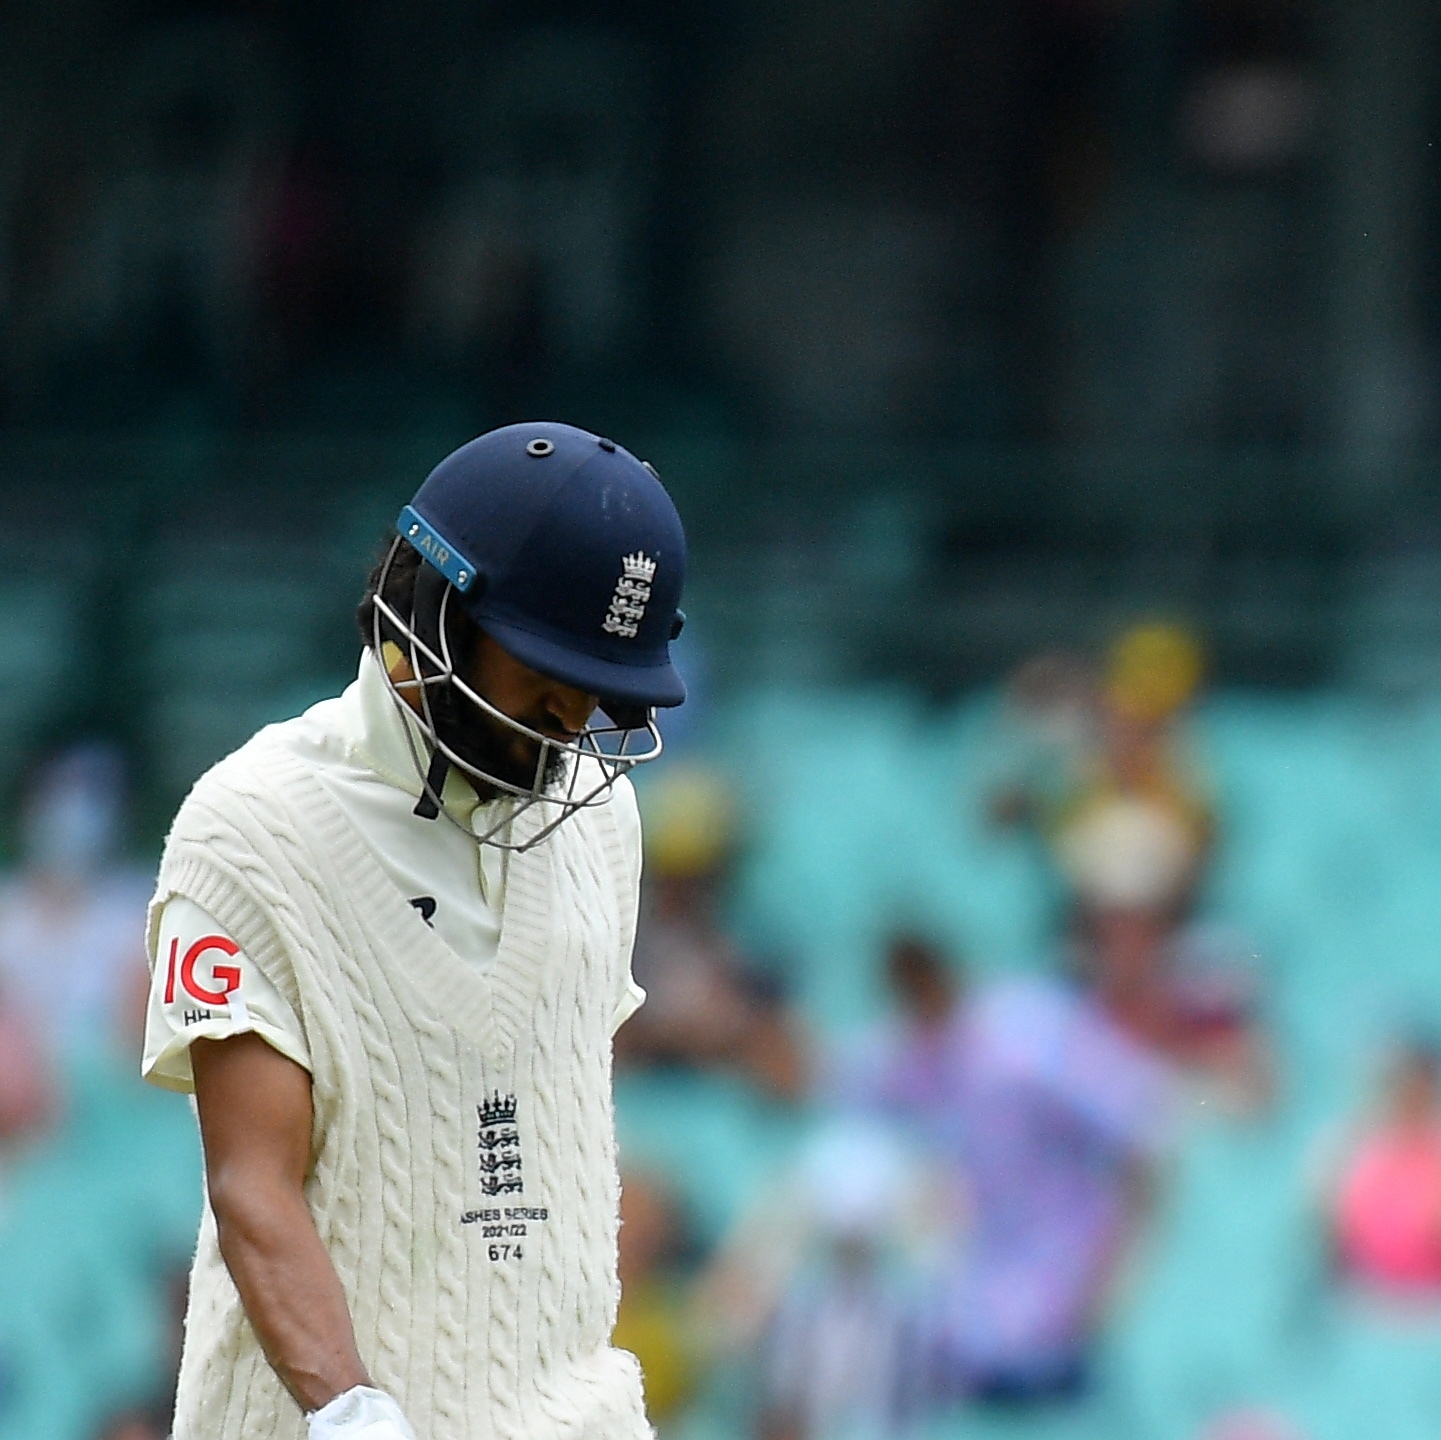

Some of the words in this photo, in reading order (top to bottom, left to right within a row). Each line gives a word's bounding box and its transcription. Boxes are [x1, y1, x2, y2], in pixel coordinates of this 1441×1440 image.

[421, 534, 450, 566] AIR
[164, 935, 241, 1005] IG
[184, 1010, 211, 1026] HH
[488, 1245, 523, 1261] 674
